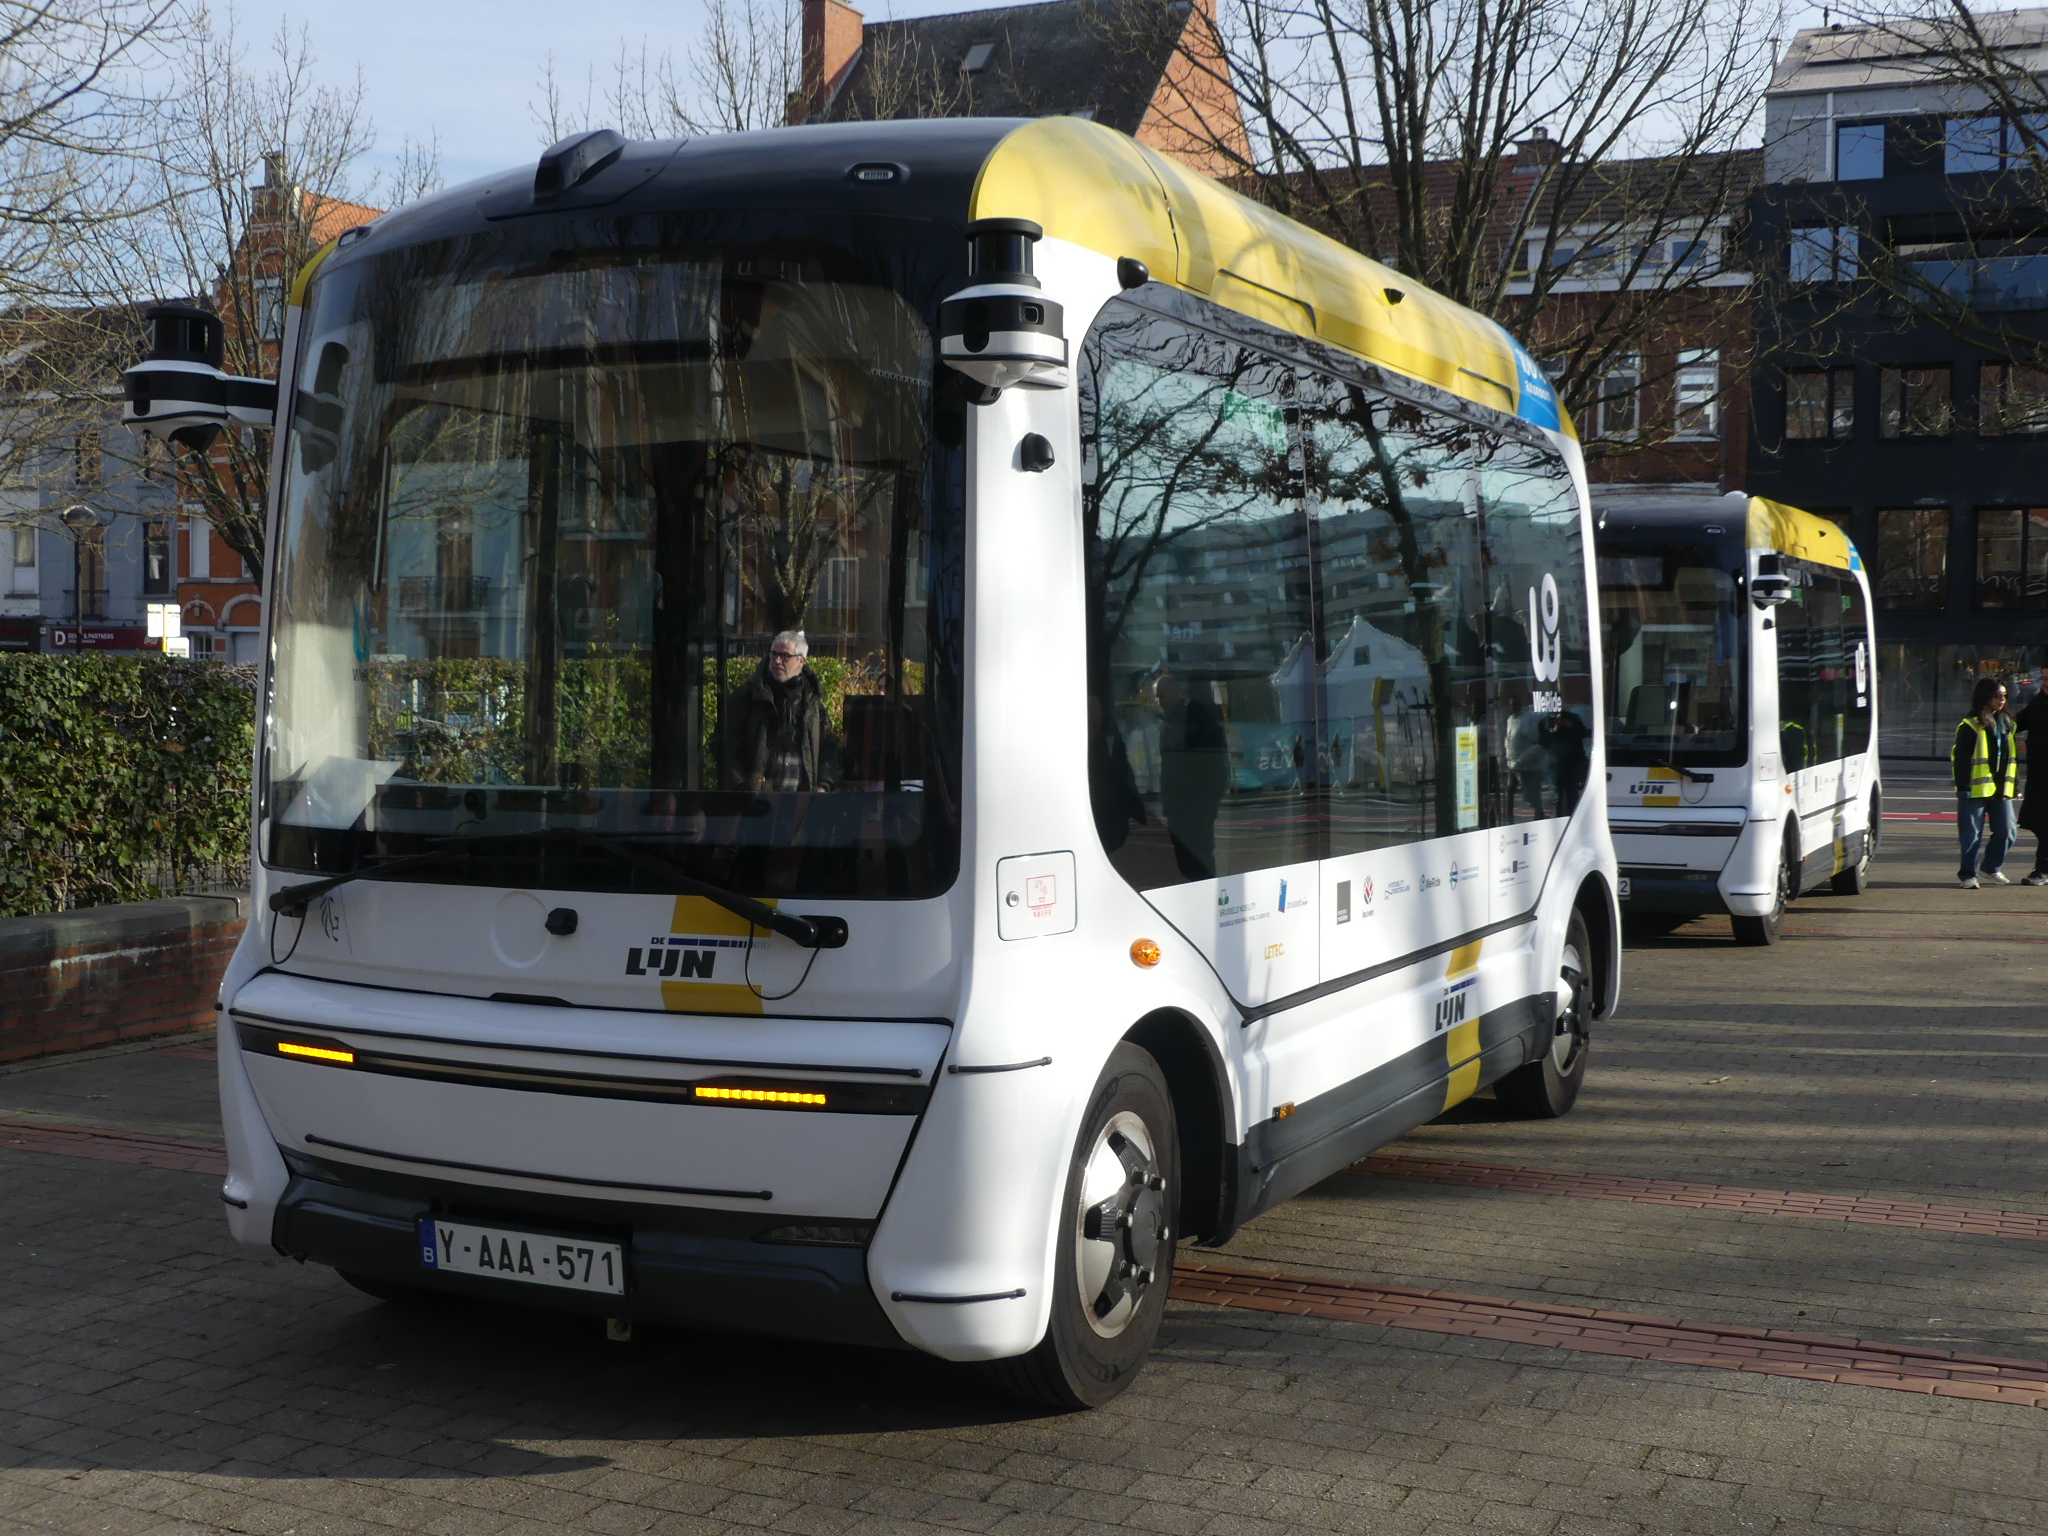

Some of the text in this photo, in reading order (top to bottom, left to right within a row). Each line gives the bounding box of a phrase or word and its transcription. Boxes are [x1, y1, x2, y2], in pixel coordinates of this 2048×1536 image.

[1532, 690, 1562, 713] WeRide
[1425, 877, 1441, 889] WeRide
[1220, 902, 1257, 917] BRUSSELS MOBILITY
[1362, 909, 1375, 919] leuven
[650, 936, 665, 945] DE
[625, 947, 717, 978] LIJN
[423, 1246, 435, 1264] B
[438, 1228, 615, 1286] Y-AAA-571
